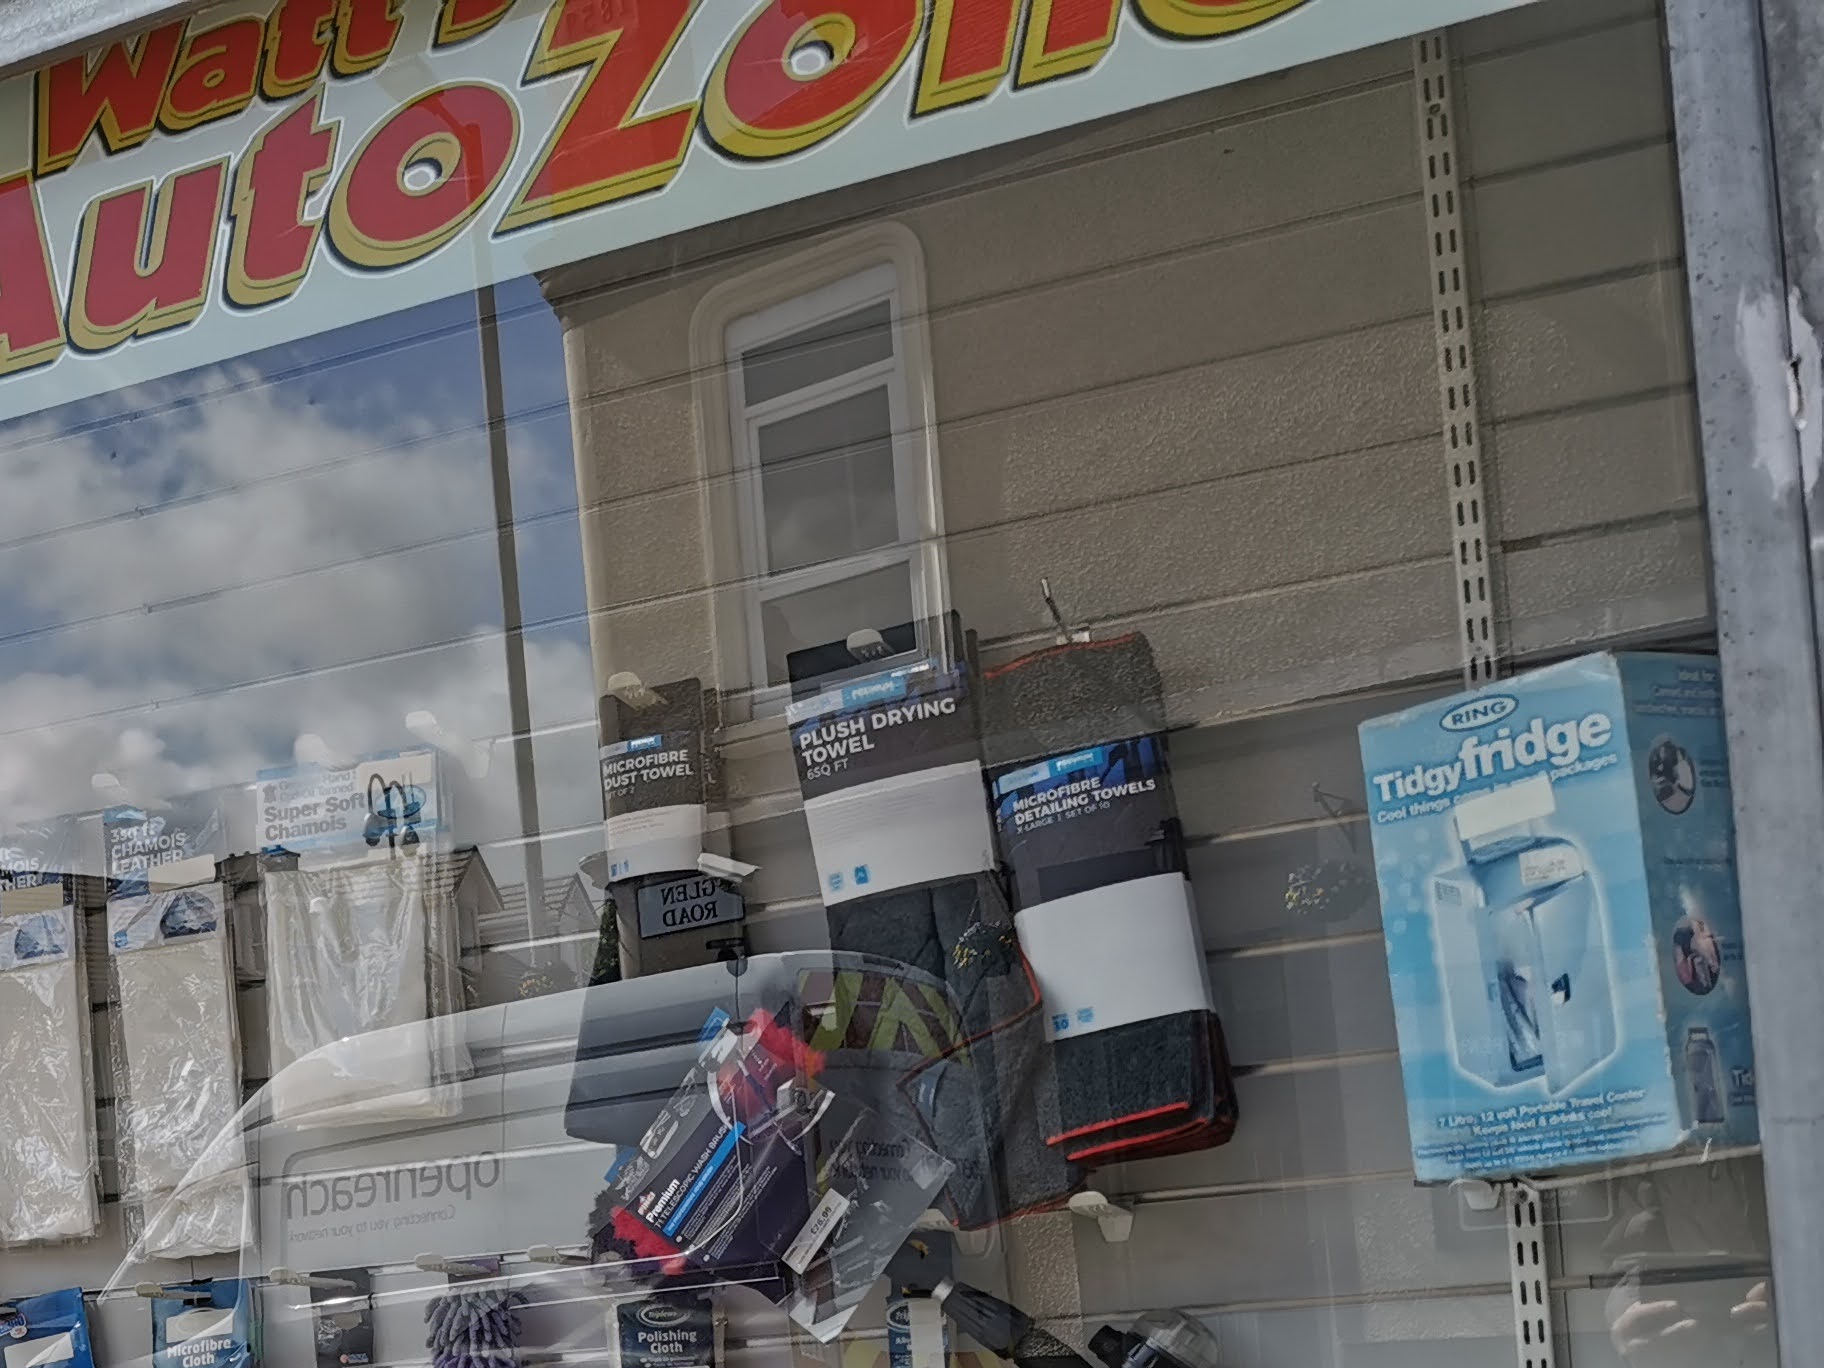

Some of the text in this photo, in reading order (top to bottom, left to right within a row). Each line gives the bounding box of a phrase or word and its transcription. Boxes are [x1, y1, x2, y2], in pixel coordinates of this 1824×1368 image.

[34, 0, 506, 179] Watt
[798, 697, 957, 751] PLUSH DRYING
[1452, 700, 1508, 727] RING
[603, 750, 689, 776] MICROFIBRE
[802, 735, 875, 769] TOWEL
[603, 764, 694, 792] DUST TOWEL
[264, 792, 366, 823] Super Soft
[1012, 777, 1102, 812] MICROFIBRE
[1014, 778, 1157, 826] DETAILING TOWELS
[265, 815, 347, 841] Chamois
[111, 831, 187, 860] CHAMOIS
[645, 1179, 681, 1224] Premium
[166, 1338, 232, 1359] Microfibre
[637, 1329, 697, 1343] Polishing
[650, 1341, 683, 1354] Cloth
[182, 1351, 215, 1368] Cloth
